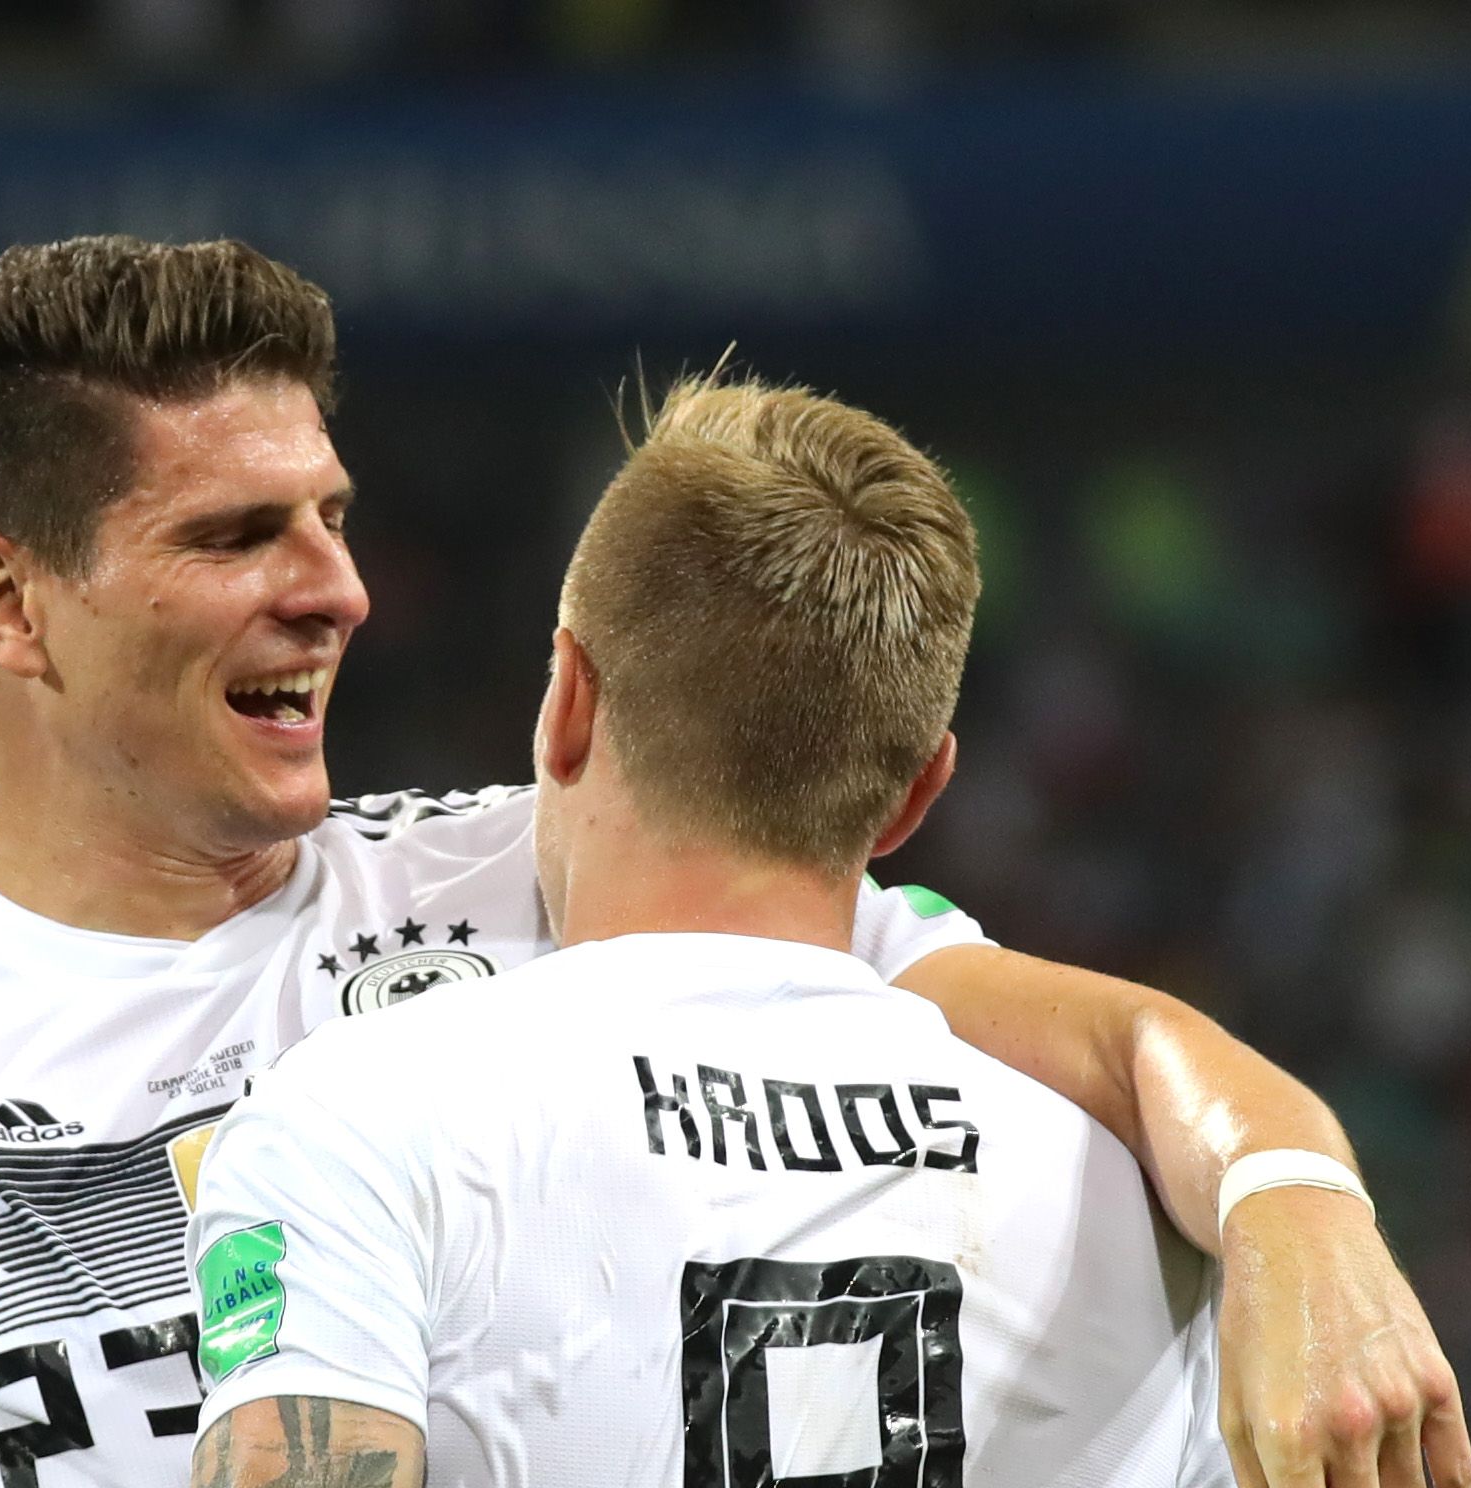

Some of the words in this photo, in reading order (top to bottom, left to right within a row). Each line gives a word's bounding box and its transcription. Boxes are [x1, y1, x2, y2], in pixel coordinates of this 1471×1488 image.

[367, 957, 449, 987] DEUTSCHER
[209, 1040, 256, 1063] SWEDEN
[214, 1057, 243, 1074] 2018
[189, 1076, 226, 1096] SOCHI
[632, 1055, 980, 1174] KROOS
